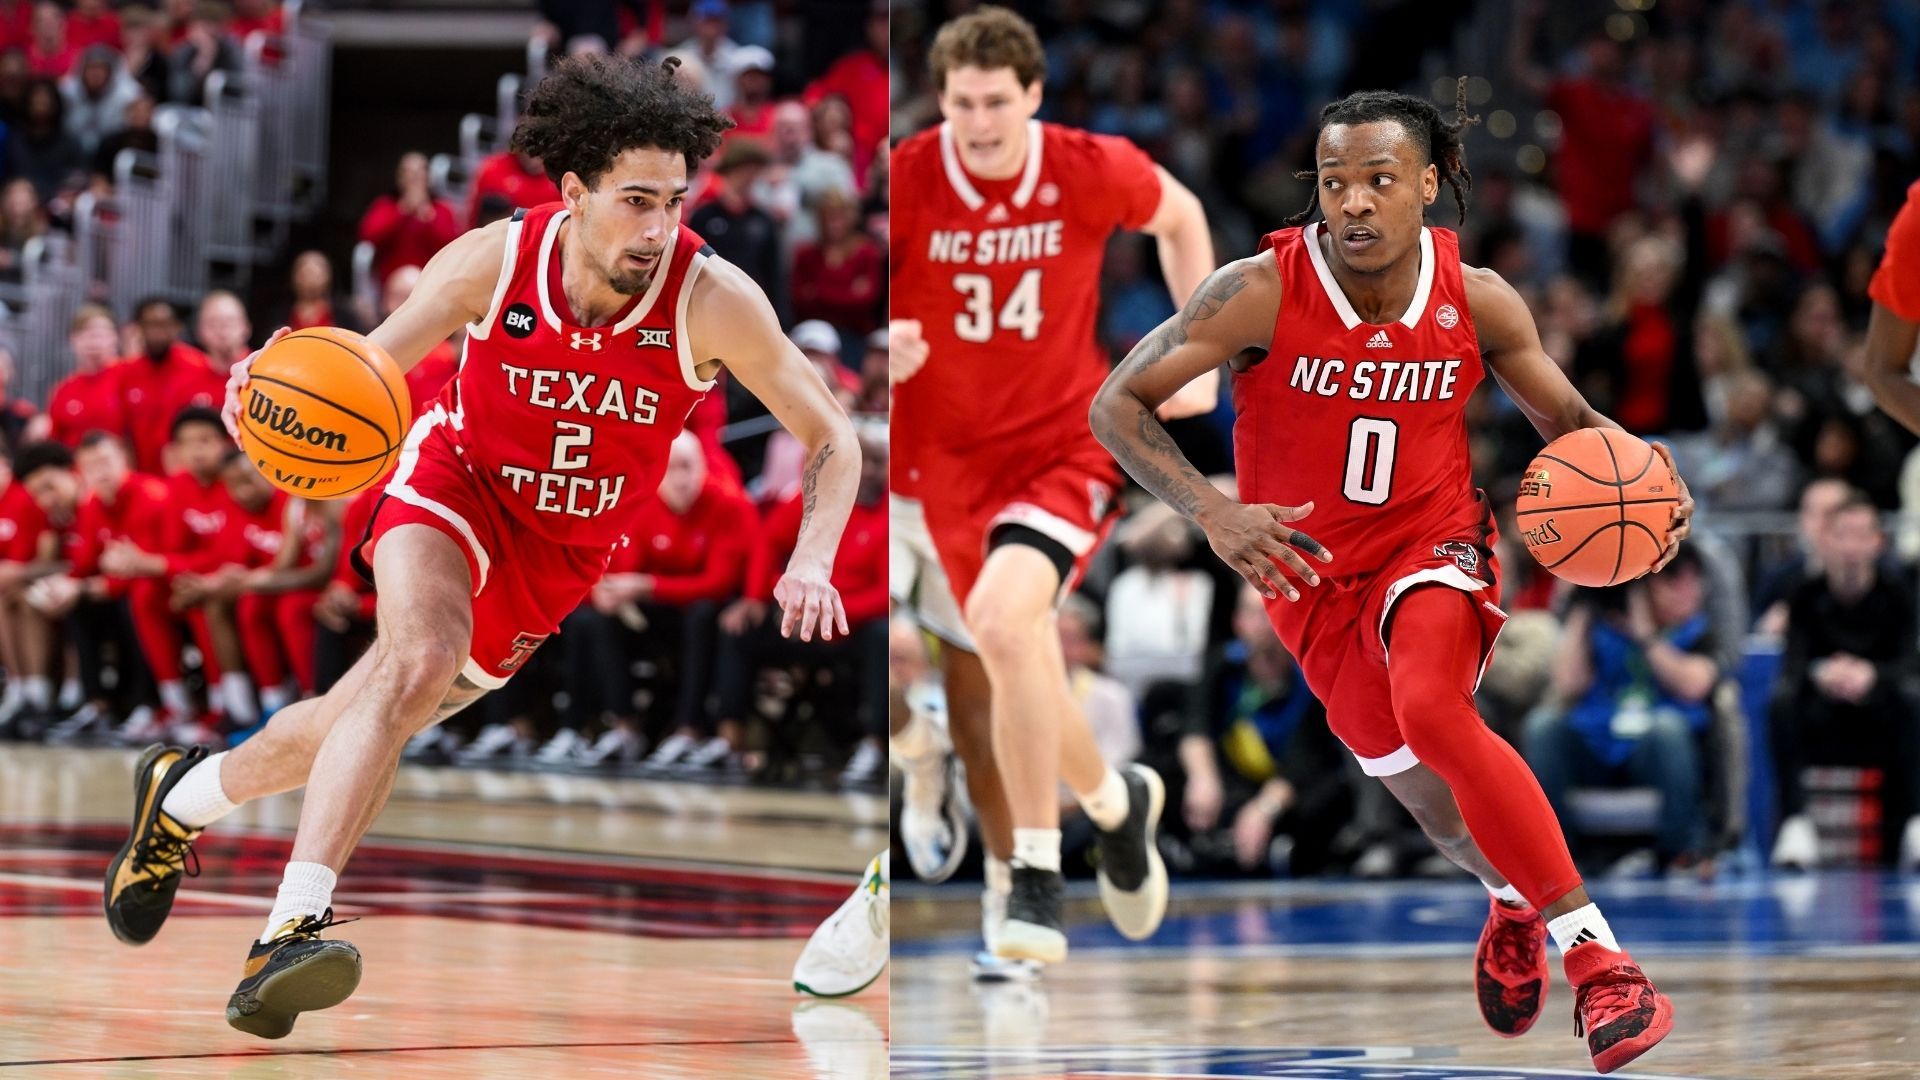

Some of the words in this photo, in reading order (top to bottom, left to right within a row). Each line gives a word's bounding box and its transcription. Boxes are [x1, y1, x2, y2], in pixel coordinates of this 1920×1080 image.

[928, 230, 973, 263] NC
[974, 219, 1064, 265] STATE
[506, 311, 532, 331] BK
[952, 268, 1043, 343] 34
[1365, 340, 1393, 348] adidas
[501, 362, 660, 425] TEXAS
[1289, 355, 1346, 397] NC
[1348, 359, 1462, 401] STATE
[248, 388, 347, 452] Wilson
[552, 420, 593, 470] 2
[1342, 414, 1399, 507] 0
[501, 465, 625, 518] TECH
[1520, 482, 1551, 498] LEG
